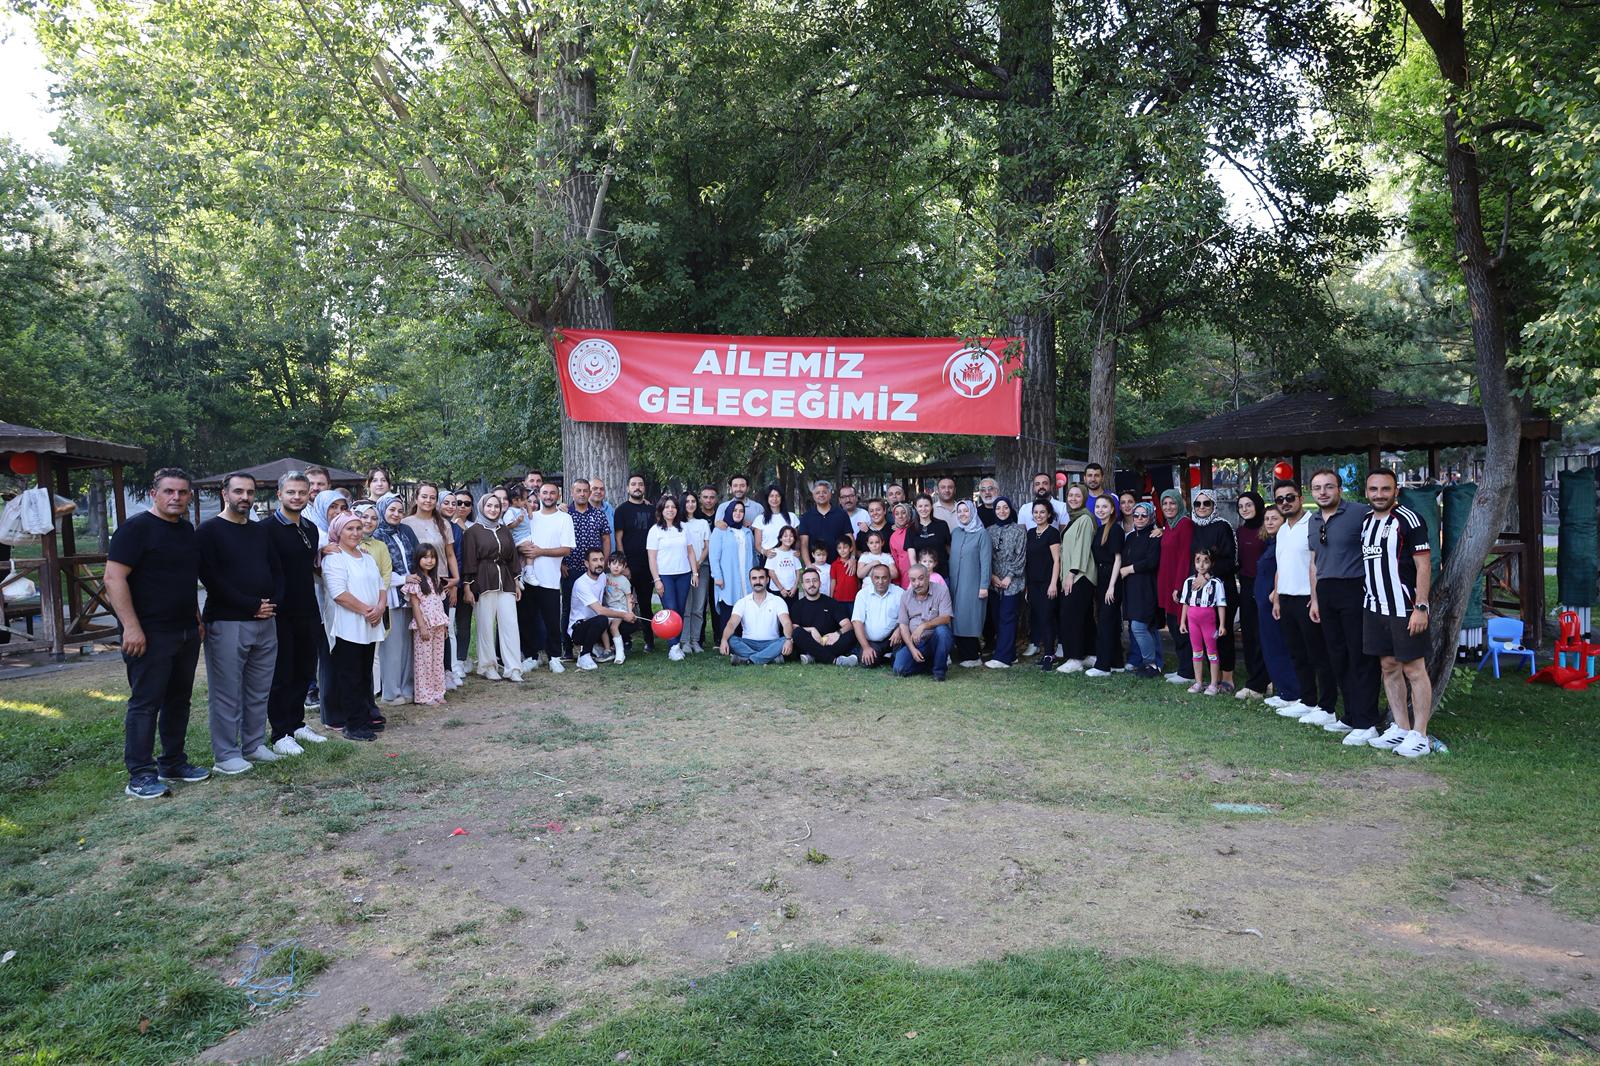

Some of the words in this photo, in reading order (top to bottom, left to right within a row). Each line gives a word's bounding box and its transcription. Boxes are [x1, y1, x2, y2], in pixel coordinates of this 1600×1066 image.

[692, 344, 864, 378] AİLEMİZ
[639, 383, 918, 421] GELECEĞİMİZ
[1362, 545, 1382, 555] beko
